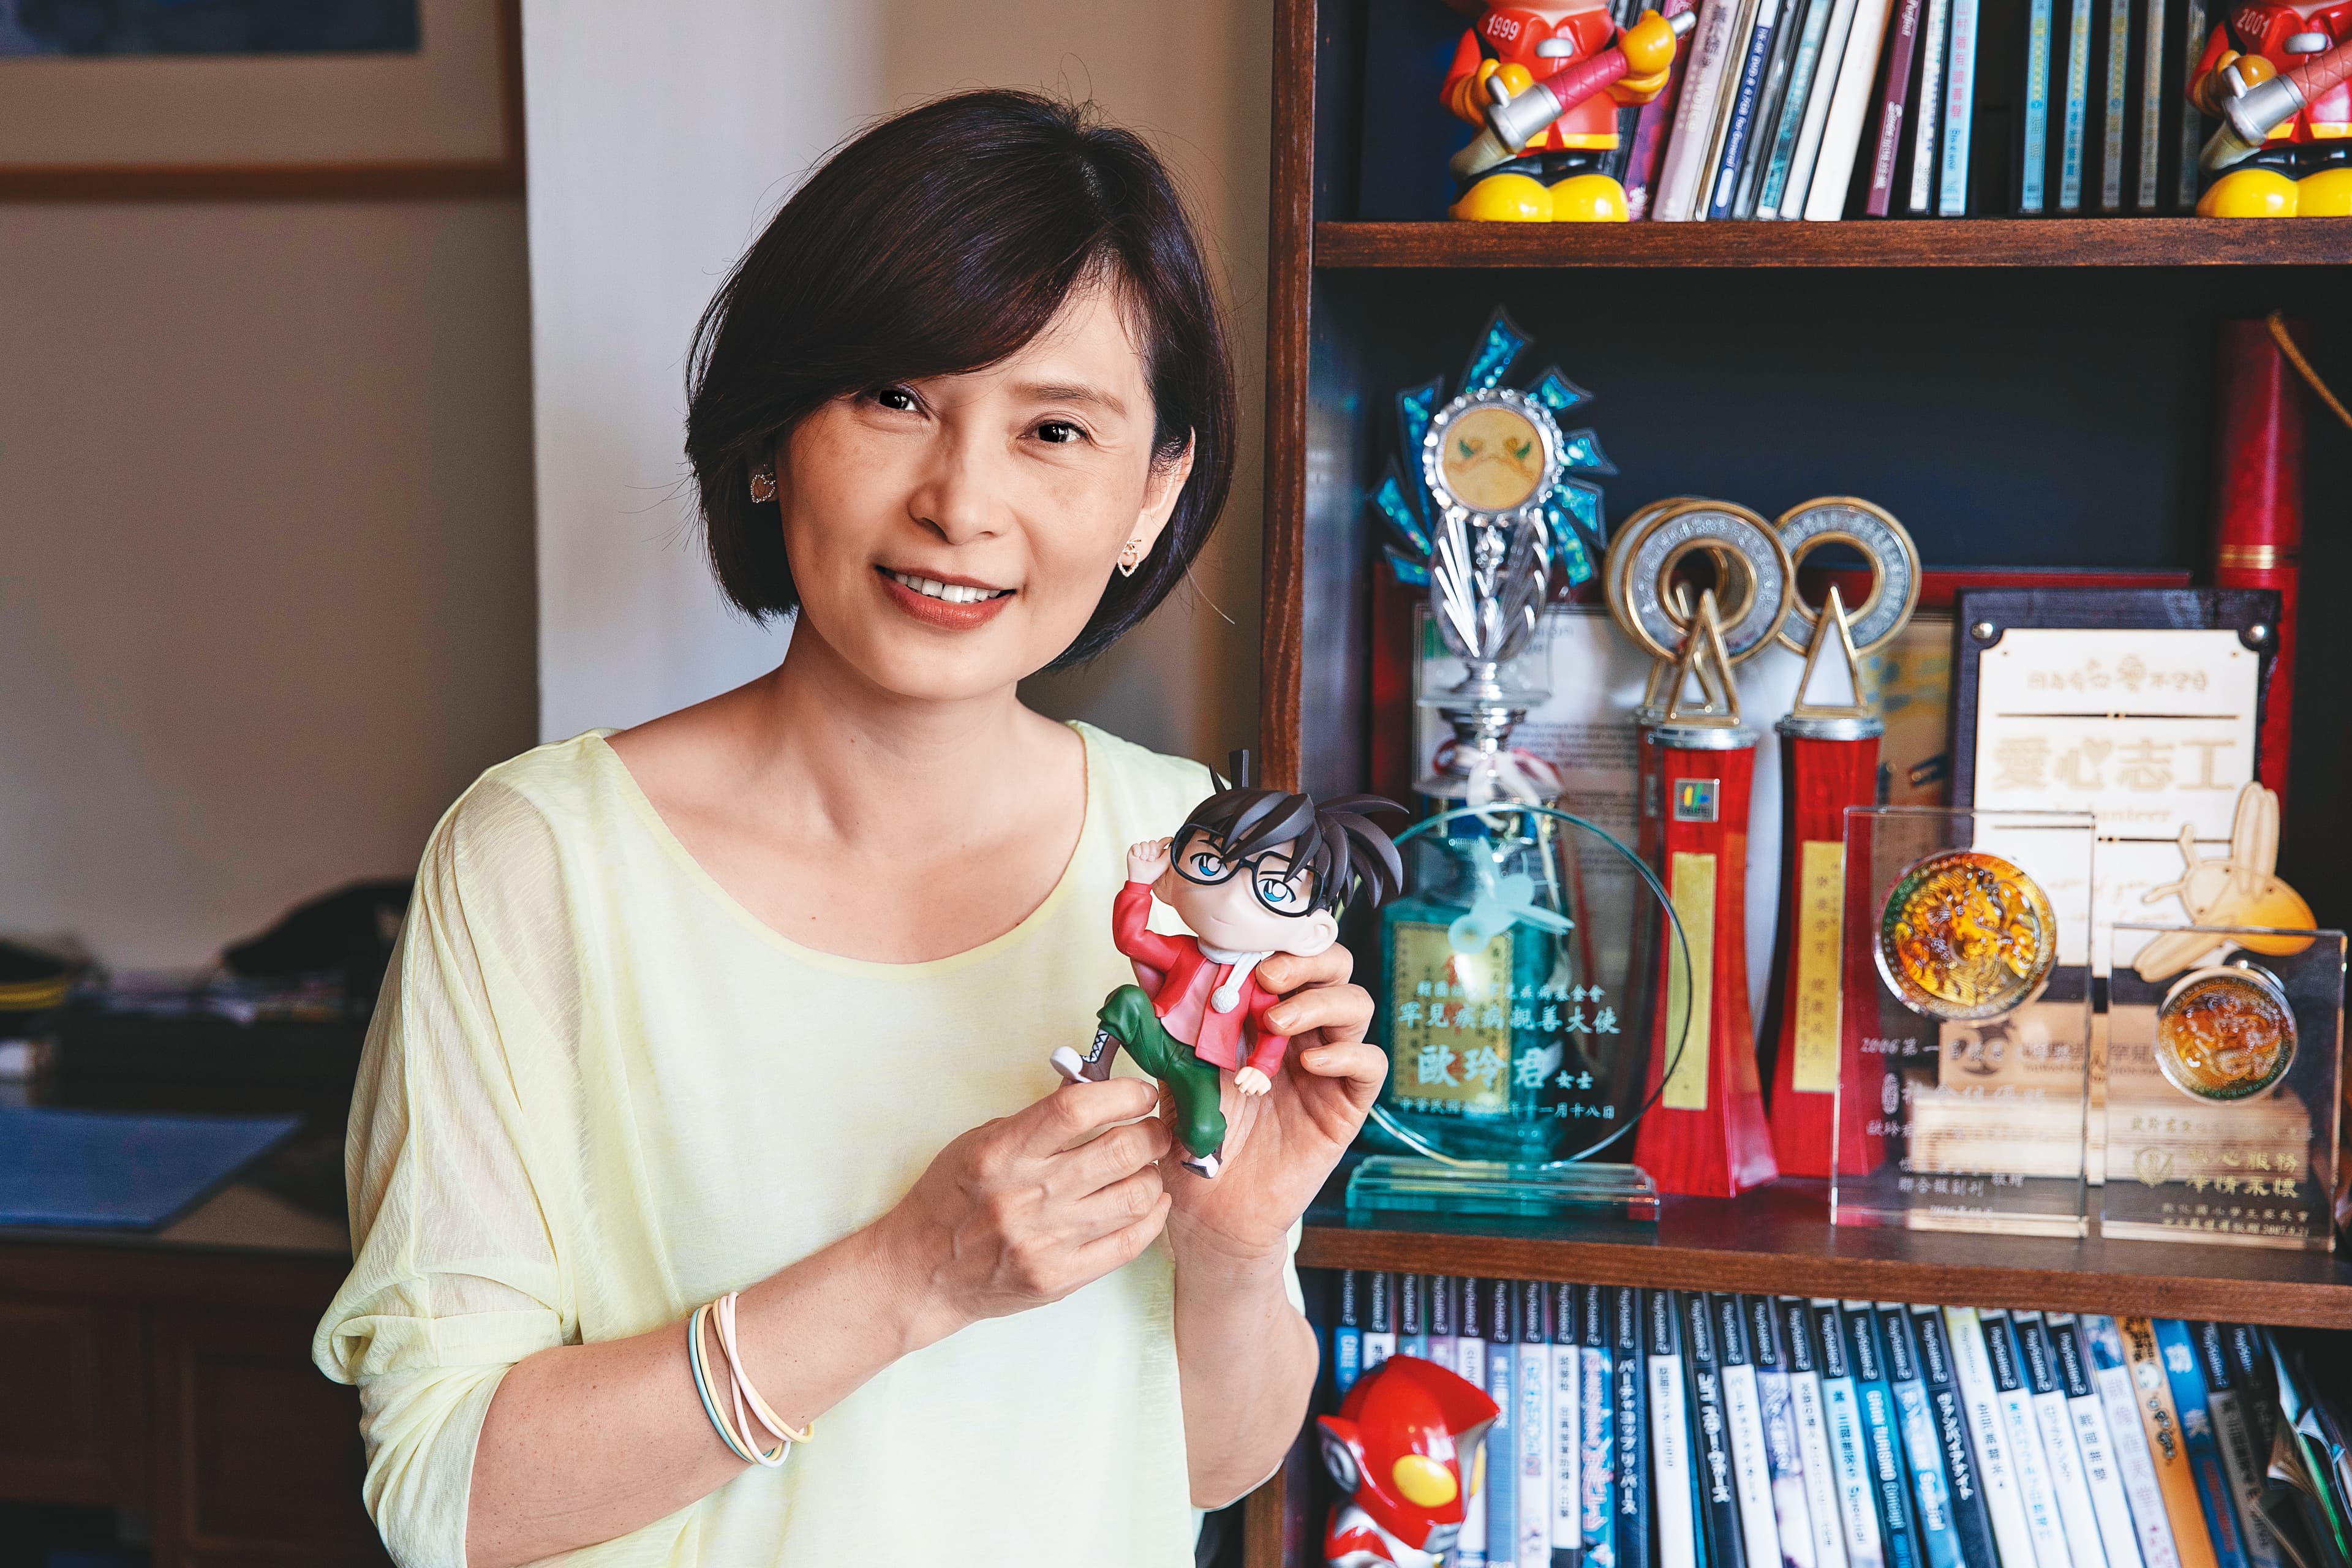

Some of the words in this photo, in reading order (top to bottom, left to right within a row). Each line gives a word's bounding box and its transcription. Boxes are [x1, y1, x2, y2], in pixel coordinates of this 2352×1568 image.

[1487, 13, 1520, 40] 1999
[2236, 8, 2270, 38] 2001
[1992, 736, 2236, 793] 愛心志工
[1397, 1000, 1622, 1035] 罕見疾病親善大使
[1417, 1044, 1545, 1090] 歐玲君
[1555, 1070, 1594, 1090] 女士
[1872, 1427, 1897, 1482] TURISMO
[1847, 1482, 1868, 1546] Special
